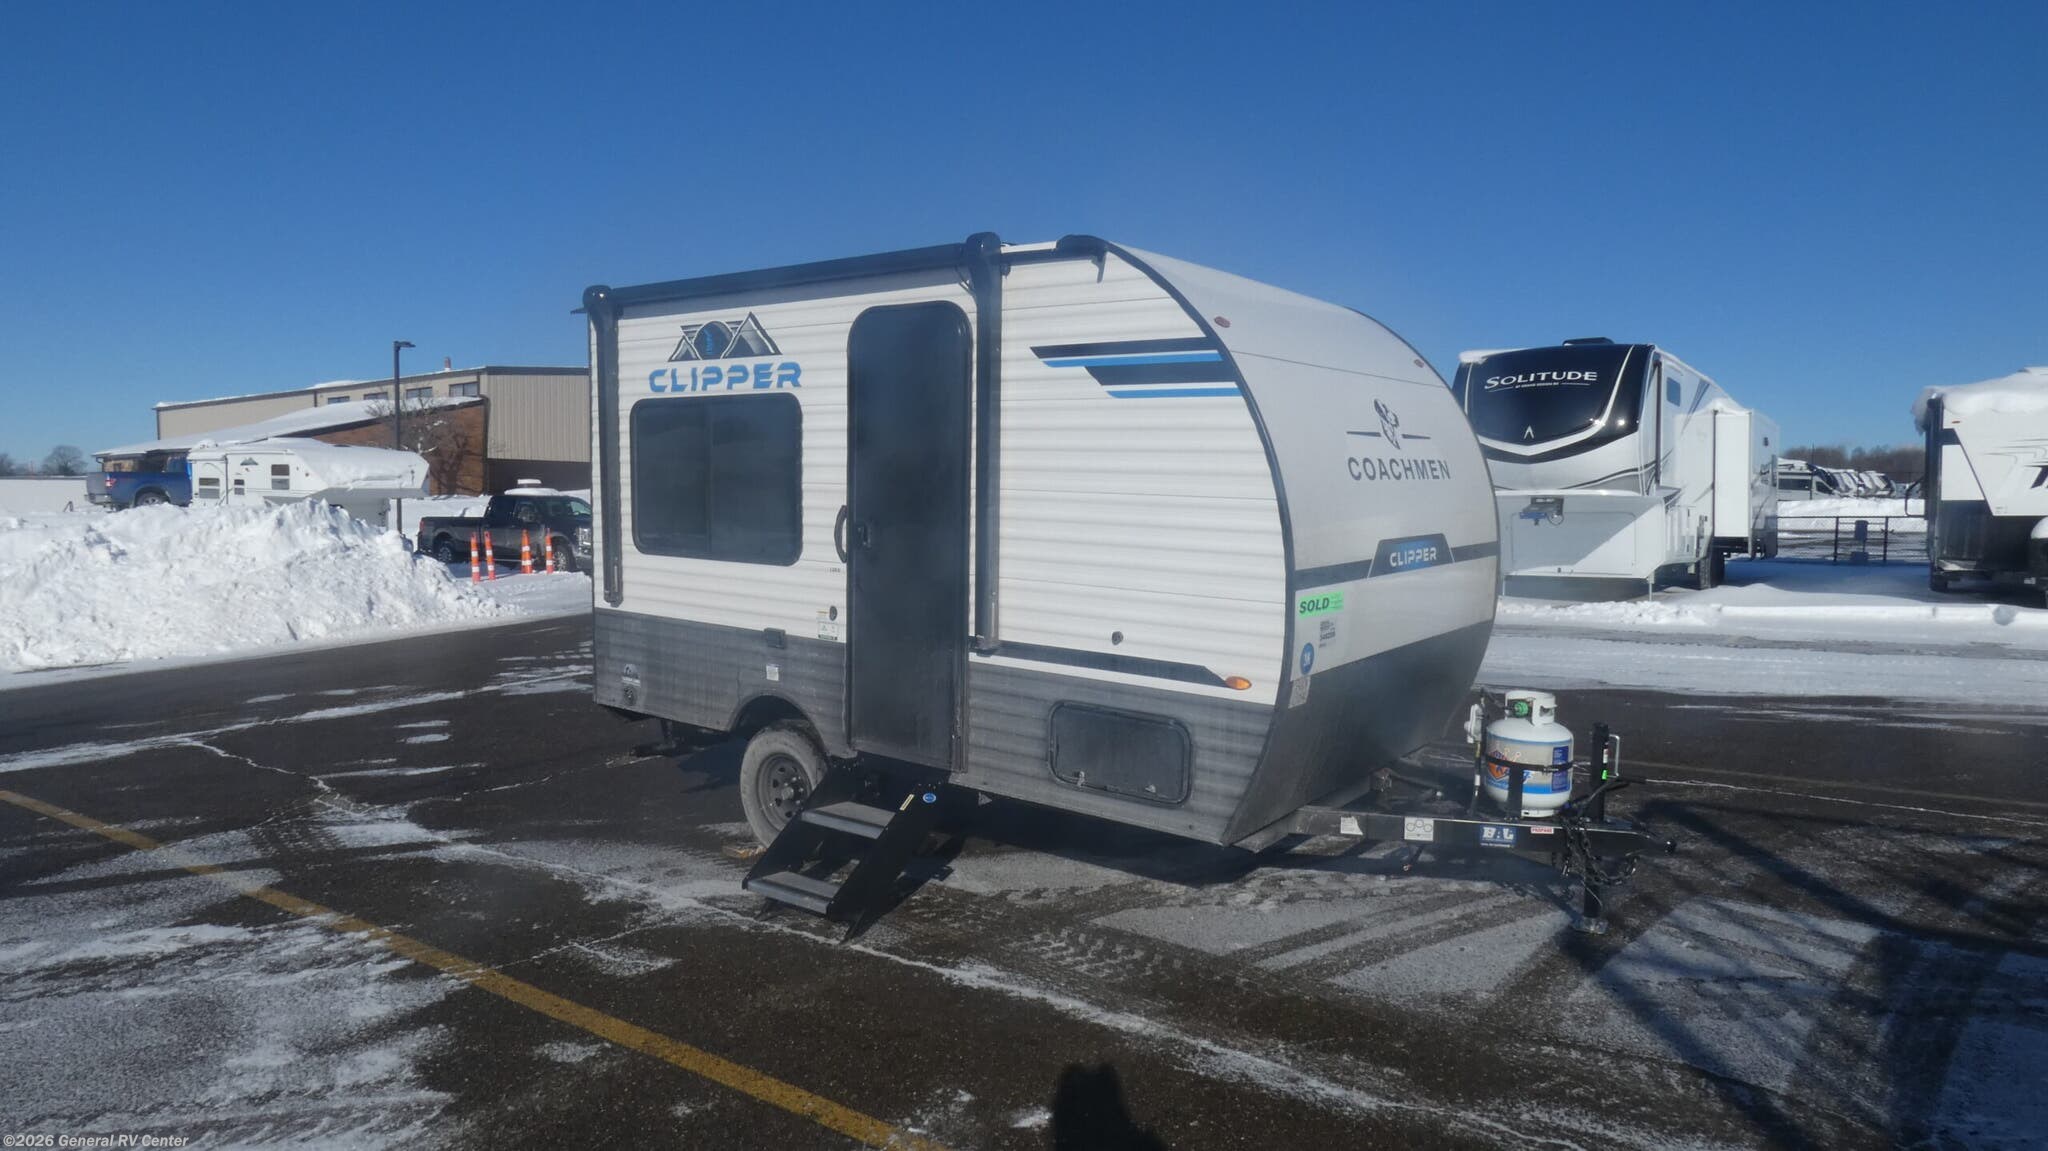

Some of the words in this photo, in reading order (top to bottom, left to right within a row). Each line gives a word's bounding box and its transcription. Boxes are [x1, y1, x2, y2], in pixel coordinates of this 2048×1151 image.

[648, 361, 802, 393] CLIPPER
[1484, 371, 1598, 390] SOLITUDE
[1347, 456, 1452, 481] COACHMEN
[1389, 546, 1437, 568] CLIPPER
[1299, 597, 1331, 614] SOLD
